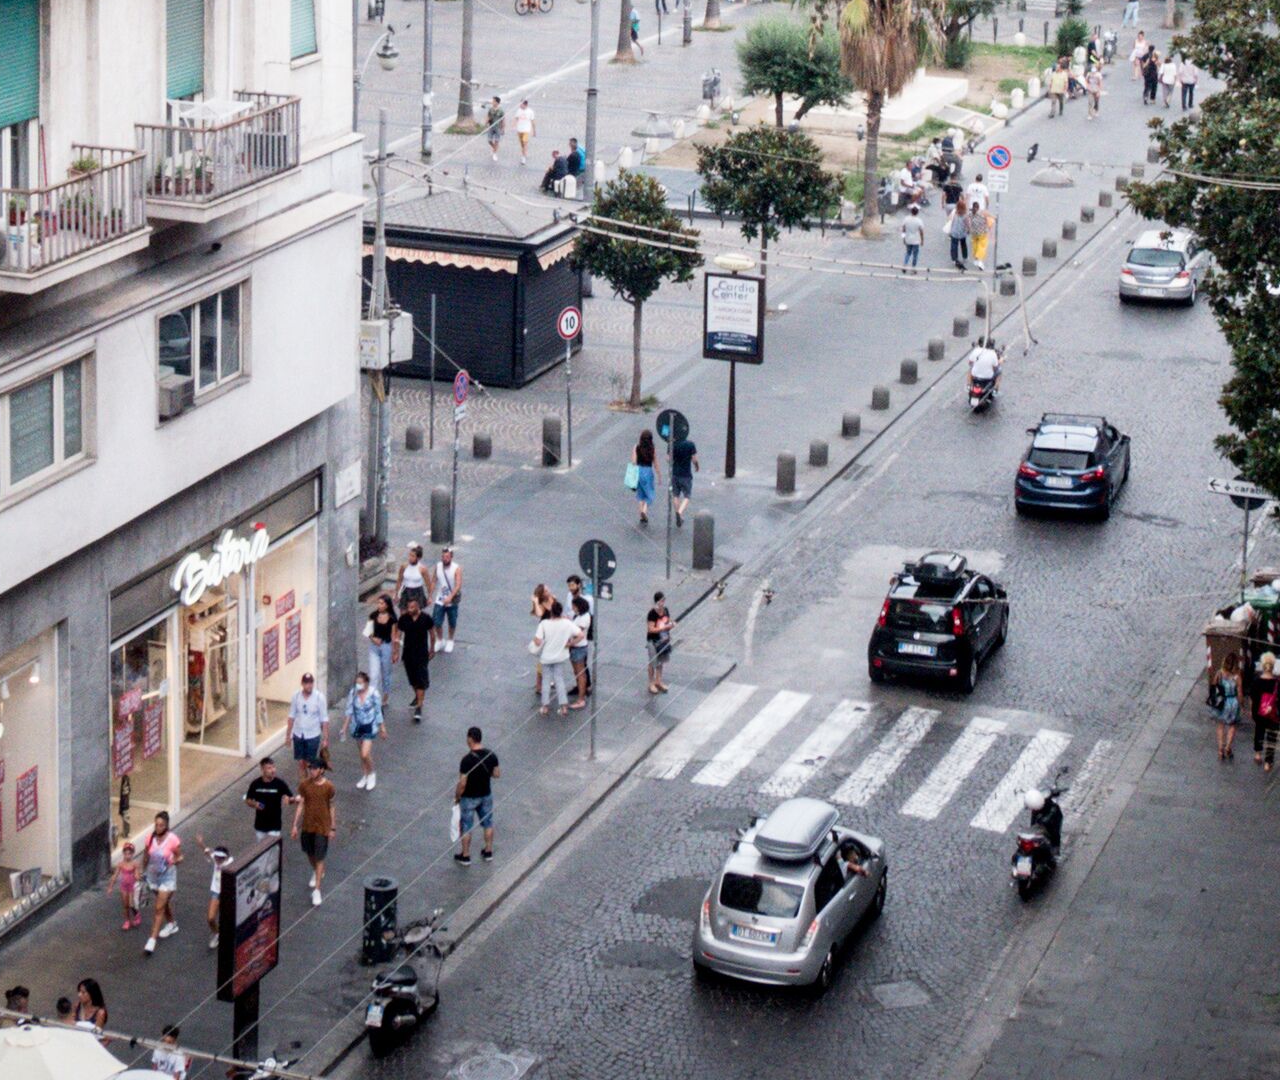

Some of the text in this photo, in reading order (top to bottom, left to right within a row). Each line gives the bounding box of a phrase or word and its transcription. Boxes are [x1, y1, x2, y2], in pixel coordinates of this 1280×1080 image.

[712, 287, 749, 300] Center
[718, 280, 755, 294] Cardio
[564, 316, 576, 331] 10
